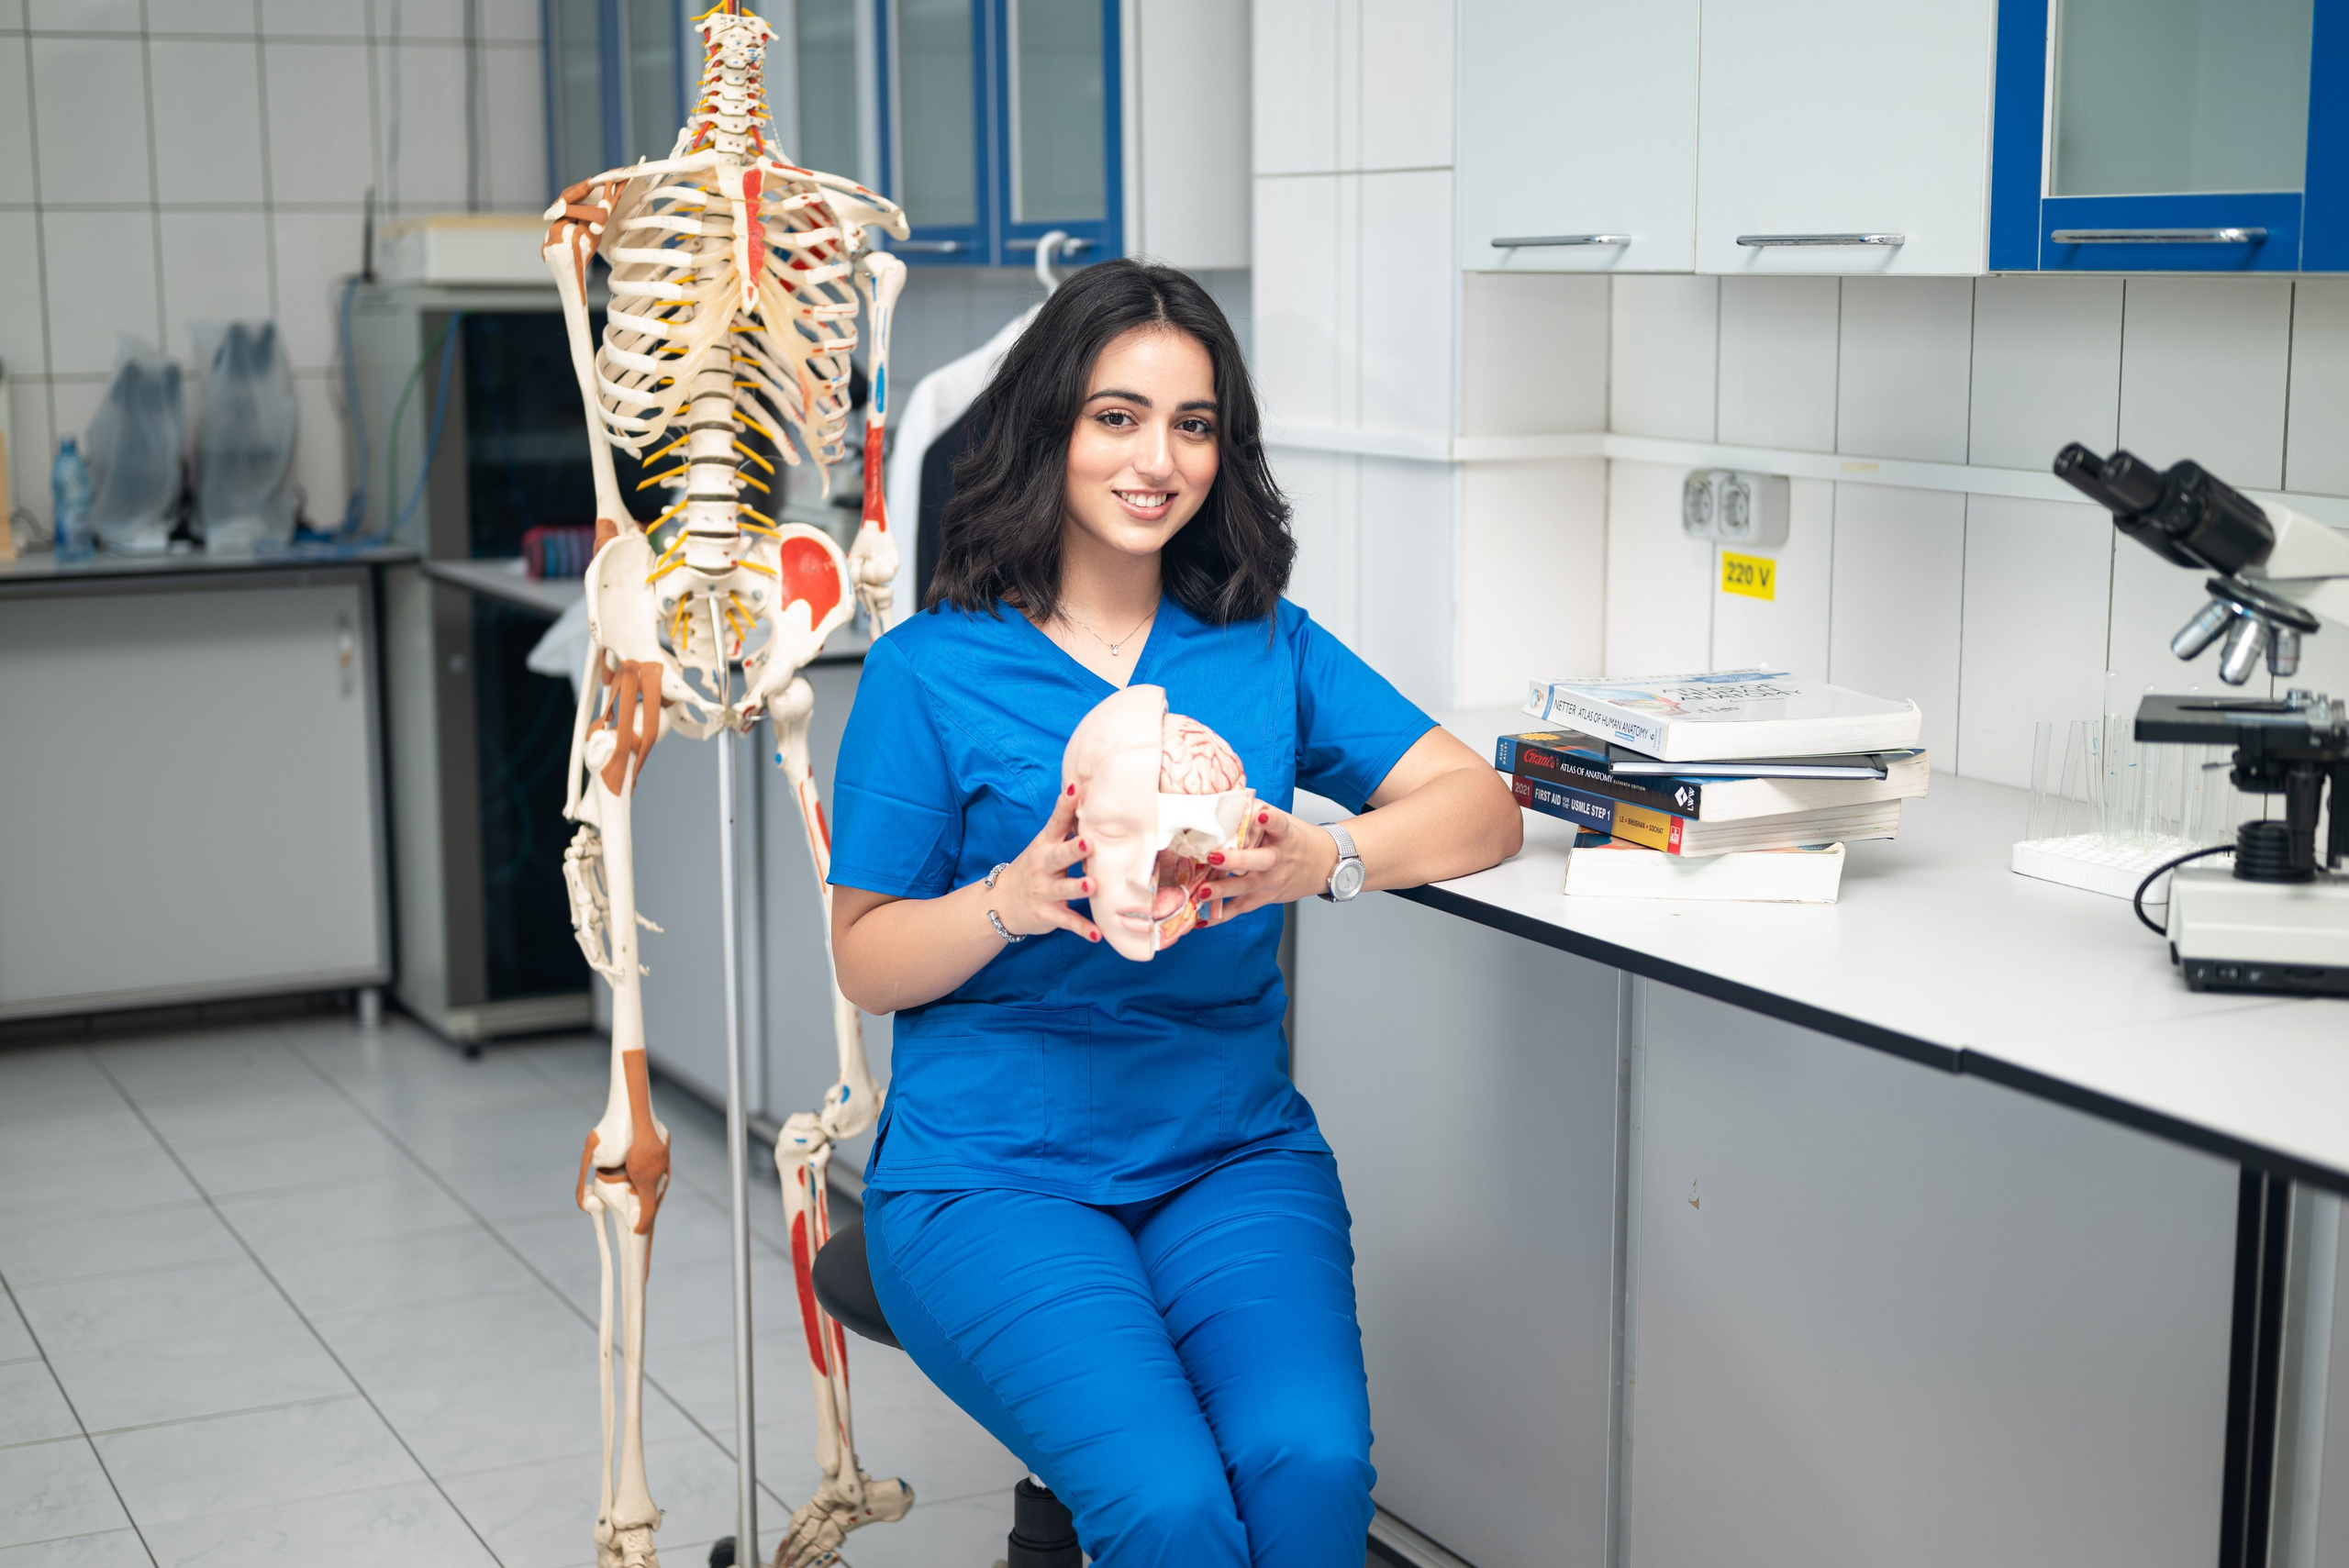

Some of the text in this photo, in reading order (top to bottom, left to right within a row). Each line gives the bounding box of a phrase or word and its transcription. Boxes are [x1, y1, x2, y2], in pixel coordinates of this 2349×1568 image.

[1727, 562, 1770, 587] 220 V
[1553, 699, 1576, 716] NETTER
[1577, 707, 1593, 722] ATLAS
[1593, 713, 1601, 723] OF
[1602, 715, 1622, 731] HUMAN
[1621, 721, 1649, 740] ANATOMY
[1524, 748, 1558, 769] Grant's
[1560, 762, 1646, 792] ATLAS OF ANATOMY ELEVENTH EDITION
[1515, 783, 1531, 796] 2021
[1535, 787, 1552, 803] FIRST
[1552, 793, 1562, 806] AID
[1571, 798, 1590, 816] USMLE
[1591, 806, 1607, 819] STEP
[1607, 809, 1610, 821] 1
[1687, 786, 1696, 811] LWW
[1628, 818, 1645, 829] BHUSHAN
[1649, 824, 1664, 834] SOCHAT
